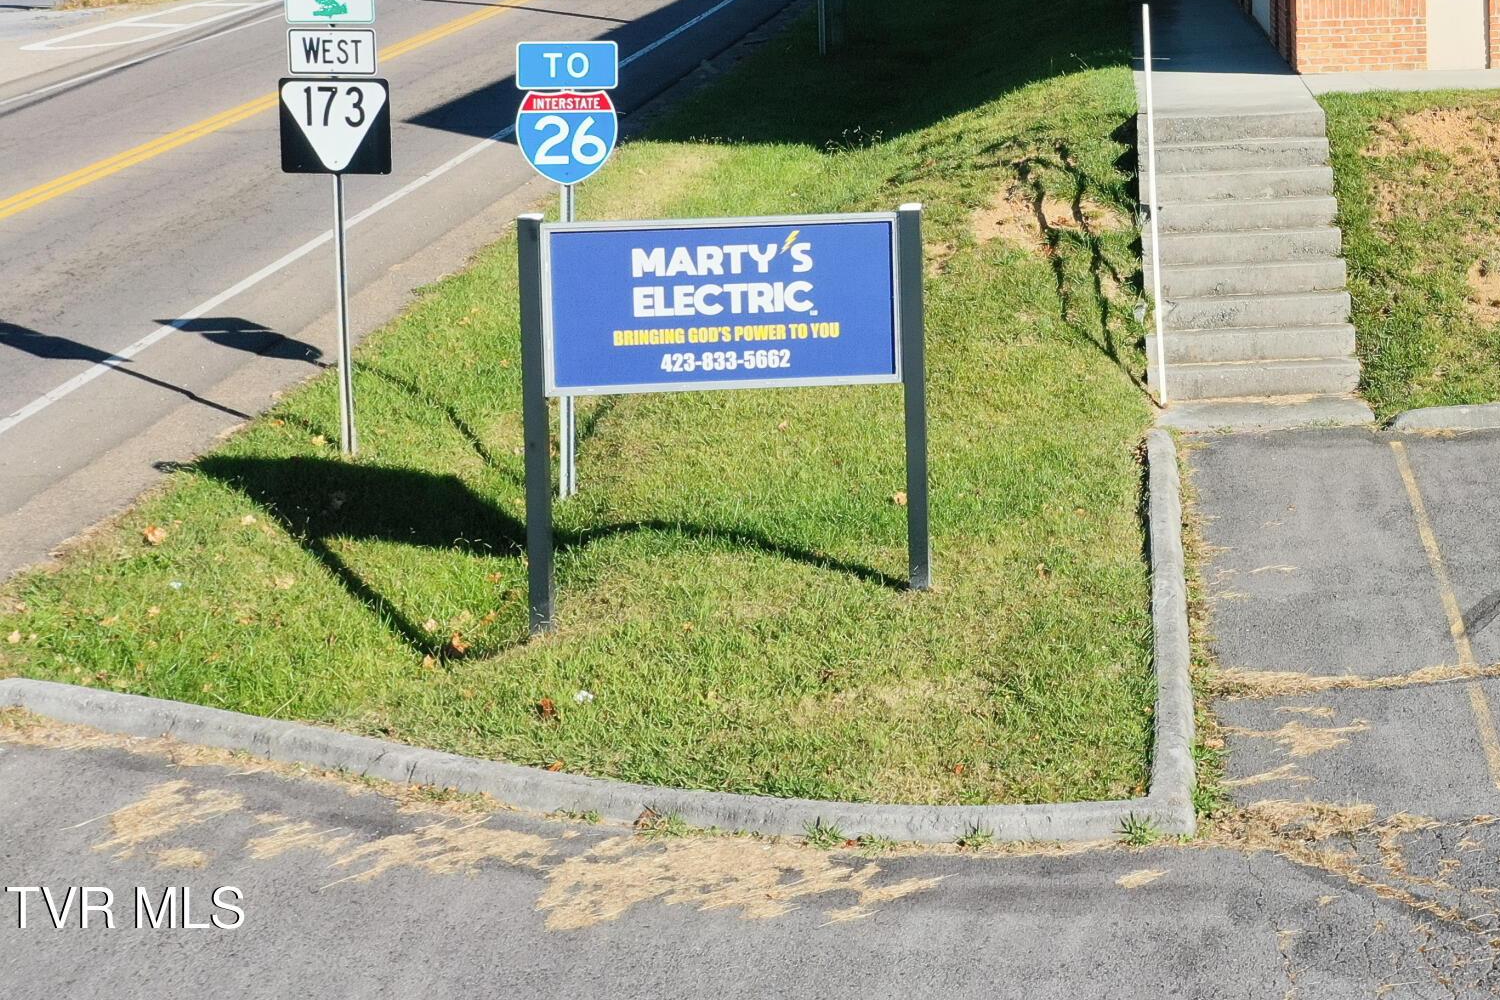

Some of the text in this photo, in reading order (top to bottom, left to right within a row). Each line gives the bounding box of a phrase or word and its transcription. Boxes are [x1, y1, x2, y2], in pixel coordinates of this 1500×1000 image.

[302, 37, 362, 64] WEST
[543, 52, 589, 78] TO
[303, 86, 365, 127] 173
[532, 97, 601, 110] INTERSTATE
[534, 115, 607, 166] 26
[631, 230, 813, 277] MARTY'S
[632, 281, 814, 318] ELECTRIC
[613, 322, 840, 346] BRINGING GOD'S POWER TO YOU
[660, 349, 790, 372] 423-833-5662
